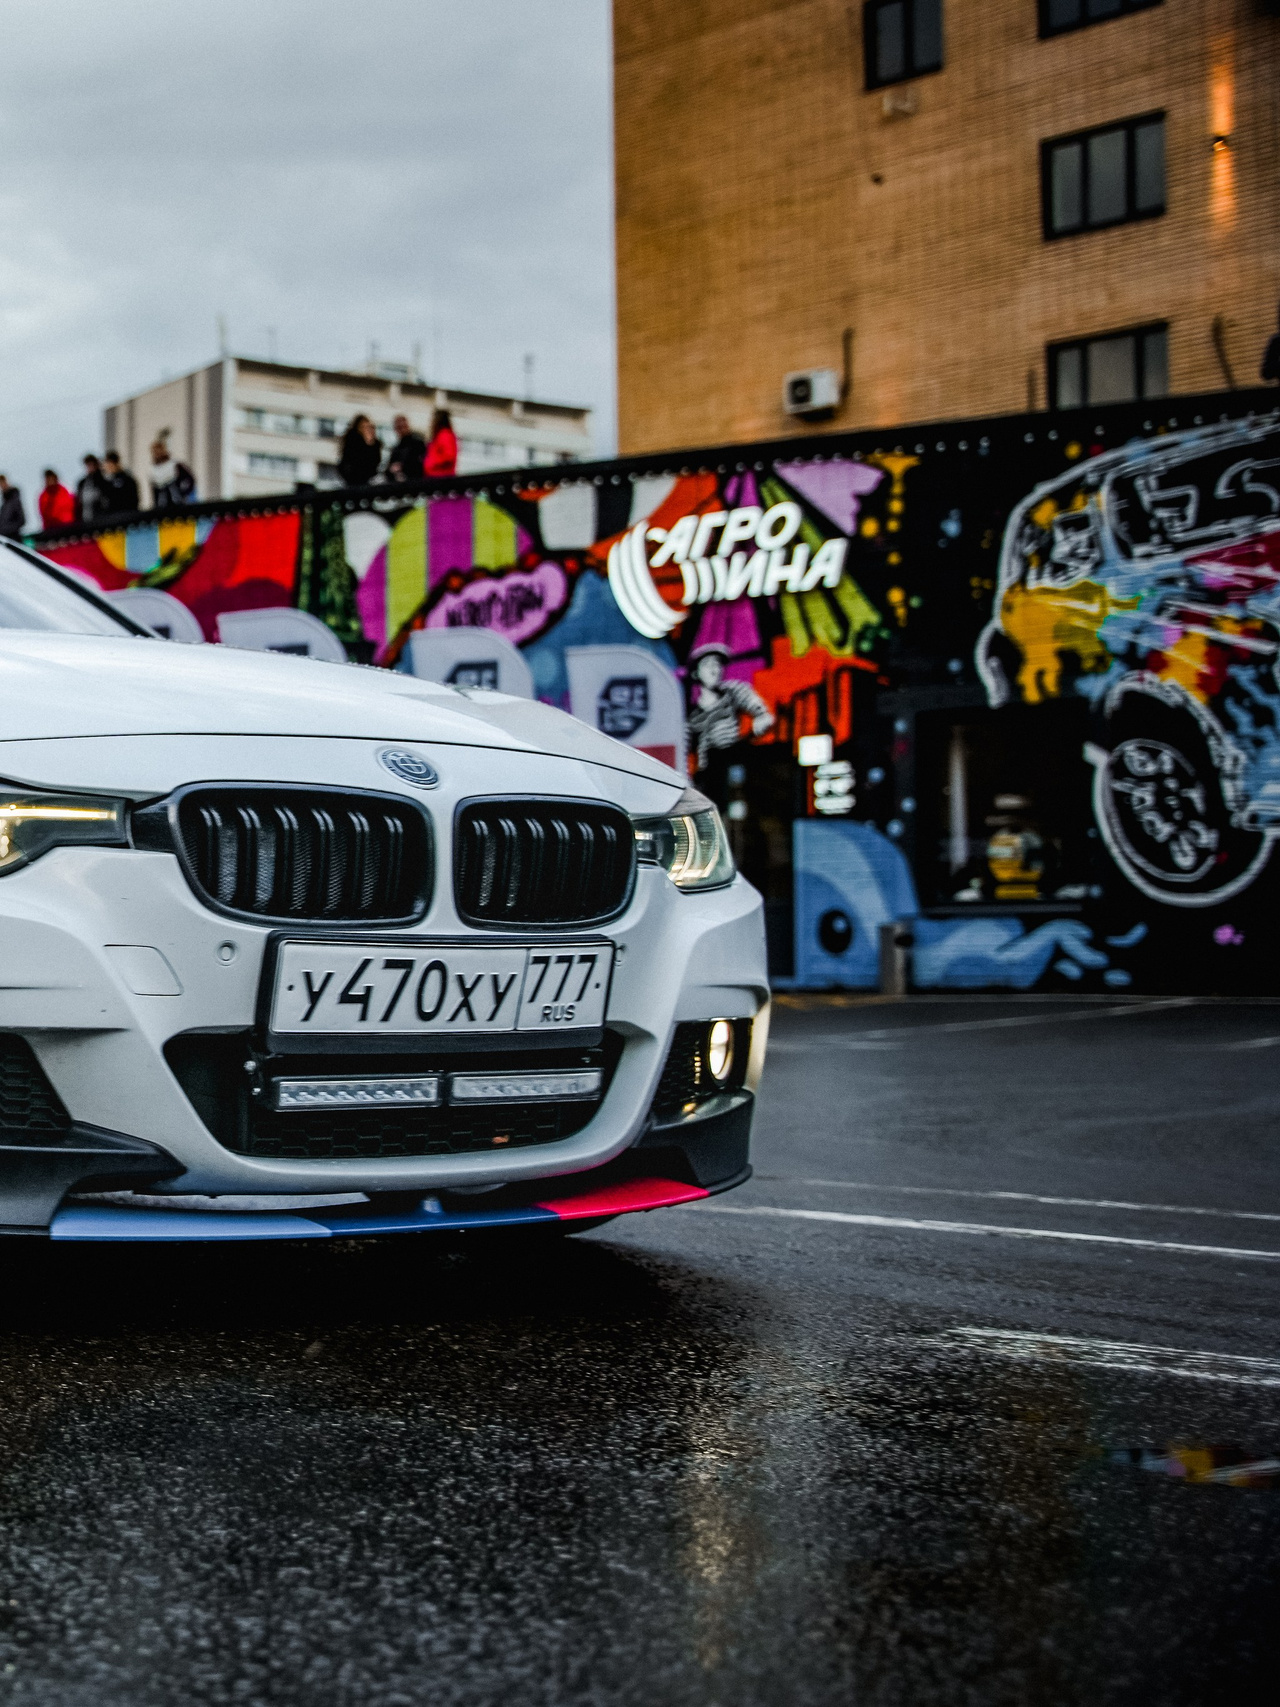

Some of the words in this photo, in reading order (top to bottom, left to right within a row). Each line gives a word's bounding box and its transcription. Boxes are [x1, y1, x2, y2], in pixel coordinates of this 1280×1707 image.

[647, 501, 803, 568] АГРО
[529, 954, 598, 1003] 777
[539, 1004, 576, 1023] RUS
